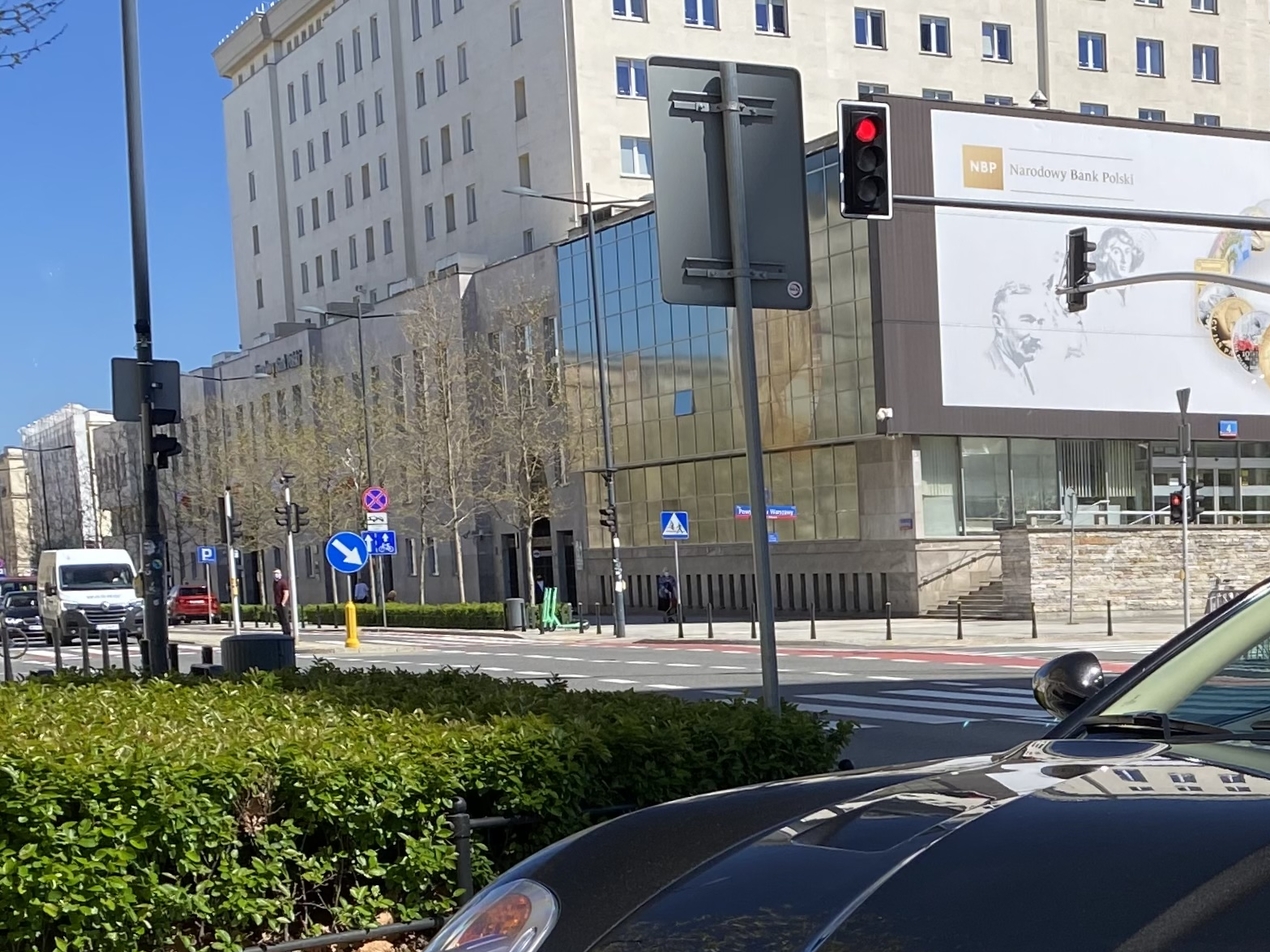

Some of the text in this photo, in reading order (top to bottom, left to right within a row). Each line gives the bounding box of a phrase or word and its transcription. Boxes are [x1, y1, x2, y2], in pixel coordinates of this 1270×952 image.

[970, 160, 997, 174] NBP
[1010, 164, 1134, 185] Narodowy Bank Polski
[201, 548, 212, 561] P
